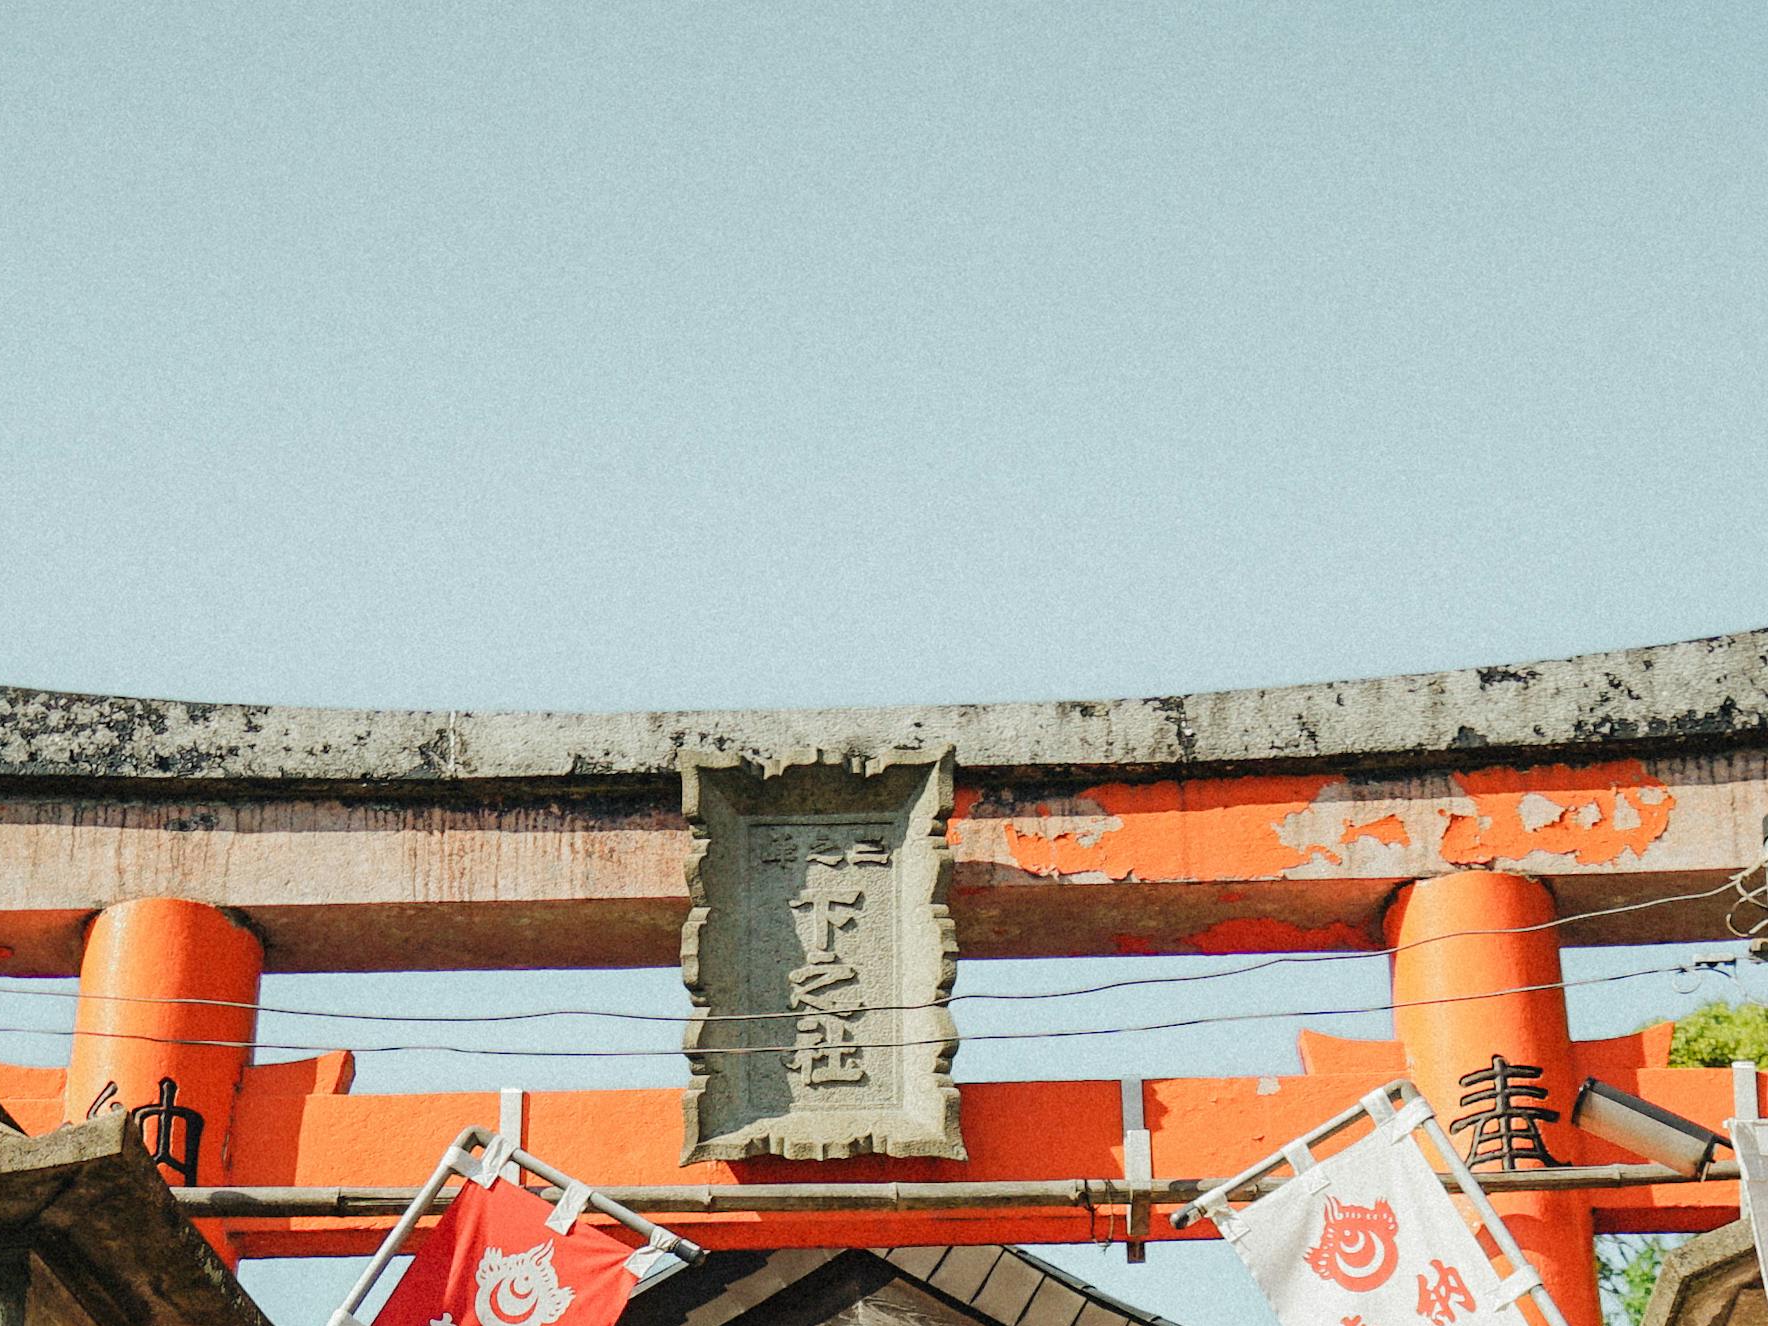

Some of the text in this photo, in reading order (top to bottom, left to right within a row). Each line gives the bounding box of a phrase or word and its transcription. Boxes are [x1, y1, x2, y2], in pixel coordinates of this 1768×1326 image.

[782, 889, 867, 1086] 下之社
[1450, 1054, 1573, 1170] 奉
